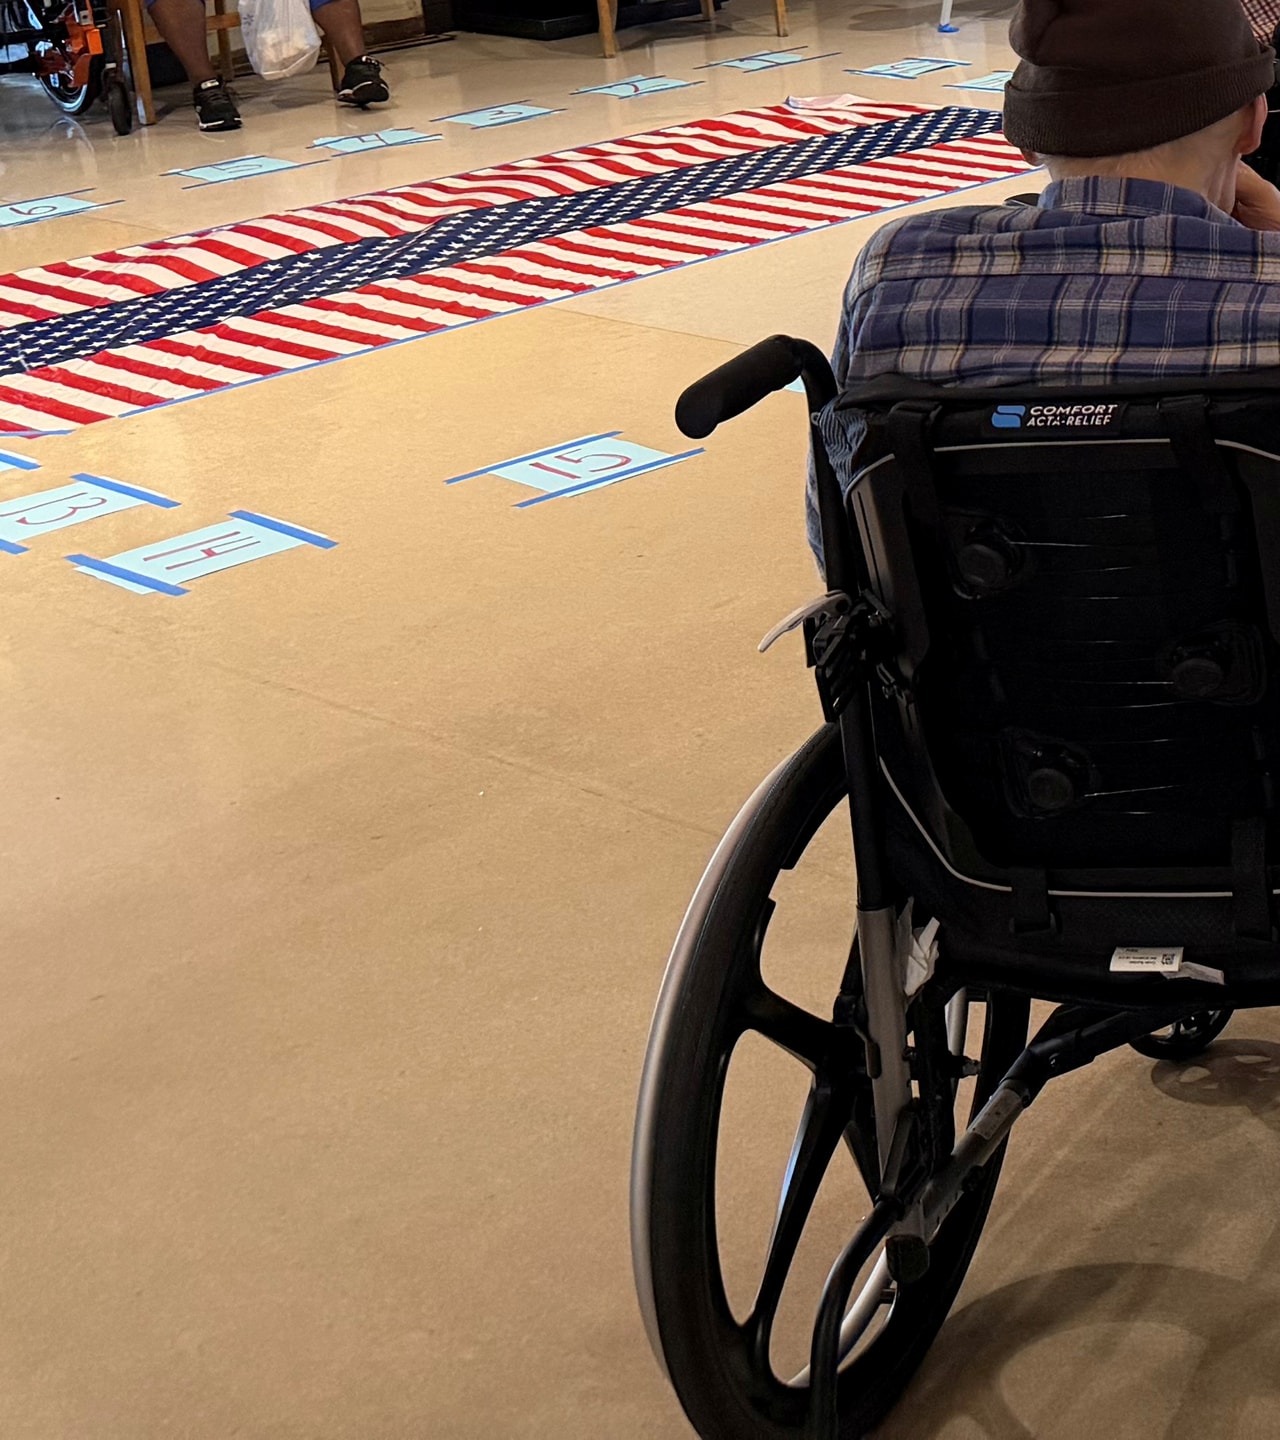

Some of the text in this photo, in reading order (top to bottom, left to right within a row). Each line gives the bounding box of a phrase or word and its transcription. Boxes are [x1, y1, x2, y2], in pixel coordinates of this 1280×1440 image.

[1029, 404, 1118, 415] COMFORT
[1026, 415, 1112, 427] ACTA-RELIEF
[528, 448, 633, 480] 15
[143, 530, 262, 571] 14
